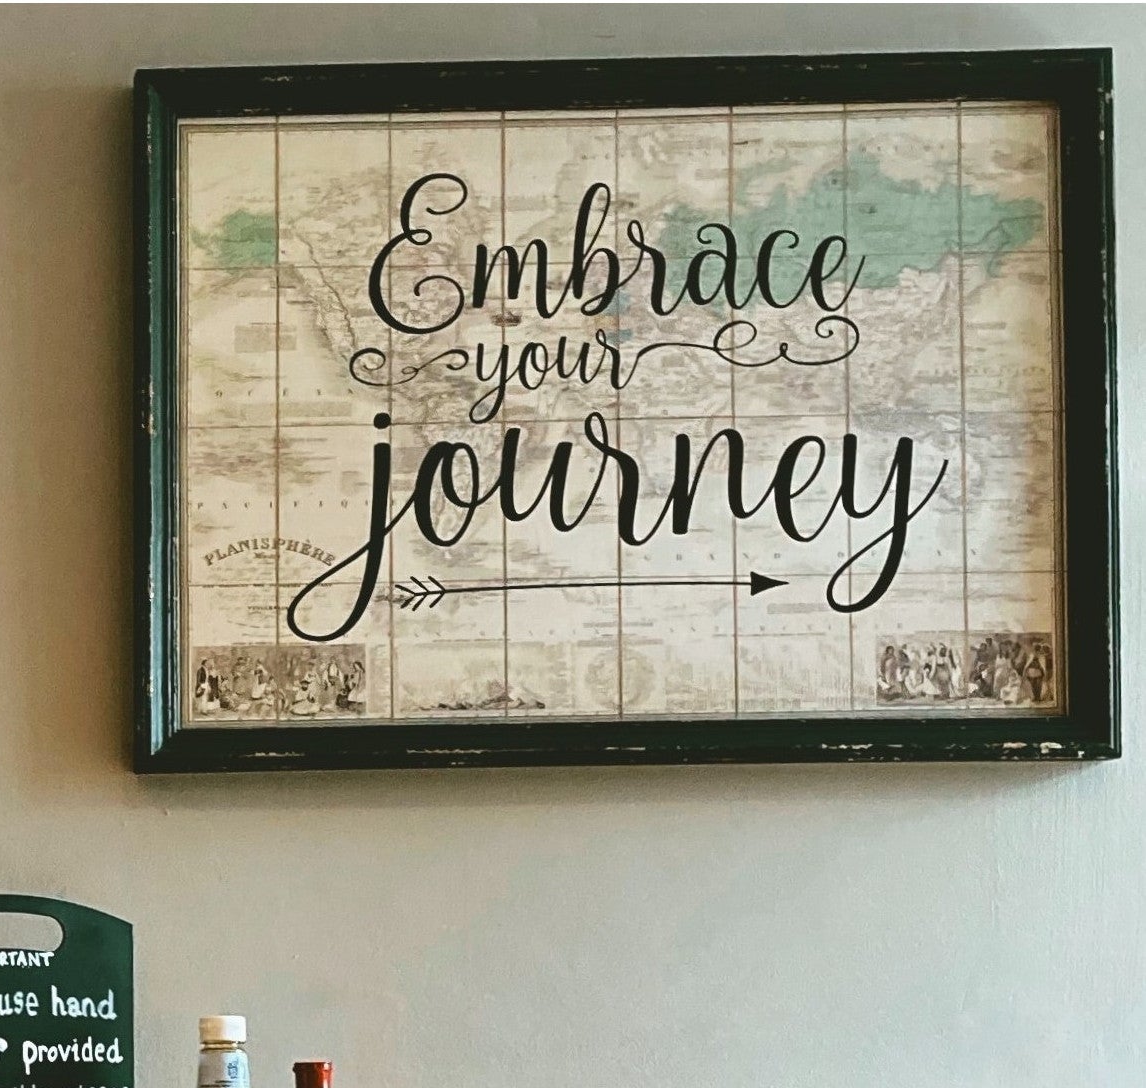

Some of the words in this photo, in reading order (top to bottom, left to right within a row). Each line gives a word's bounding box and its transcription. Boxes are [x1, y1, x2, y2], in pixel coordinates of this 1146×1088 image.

[368, 173, 866, 335] Embrace
[287, 411, 948, 642] journey
[51, 985, 118, 1020] hand
[22, 1036, 124, 1075] provided
